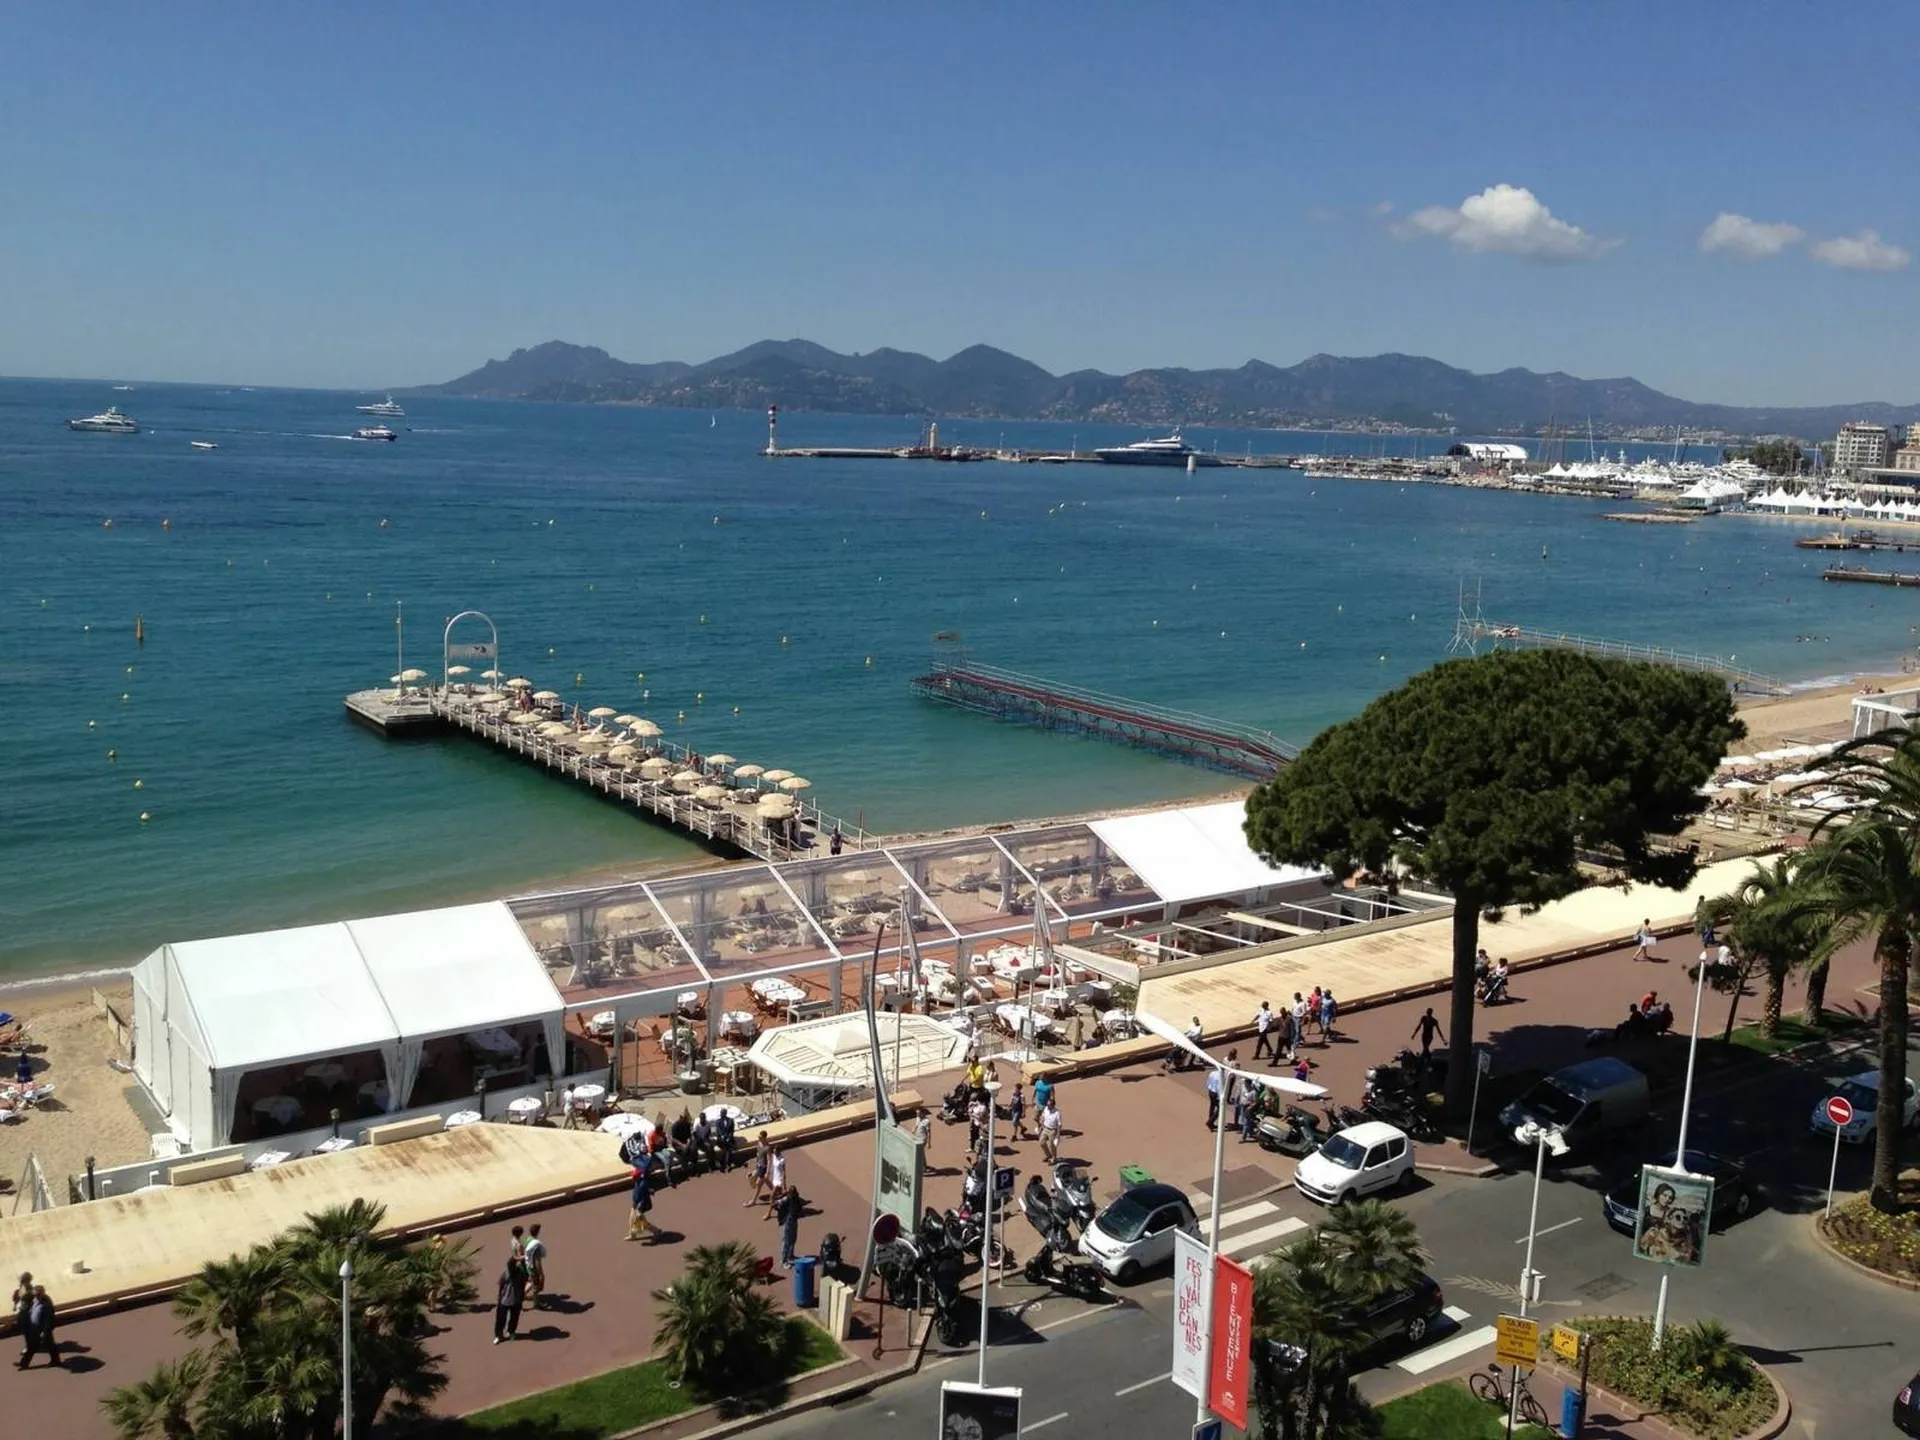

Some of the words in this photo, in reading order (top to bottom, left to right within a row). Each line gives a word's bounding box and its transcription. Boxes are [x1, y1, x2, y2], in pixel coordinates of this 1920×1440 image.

[1186, 1256, 1202, 1277] FES
[1179, 1296, 1190, 1314] DE
[1186, 1286, 1201, 1307] VAL
[1178, 1311, 1198, 1333] CAN
[1185, 1327, 1202, 1351] NES
